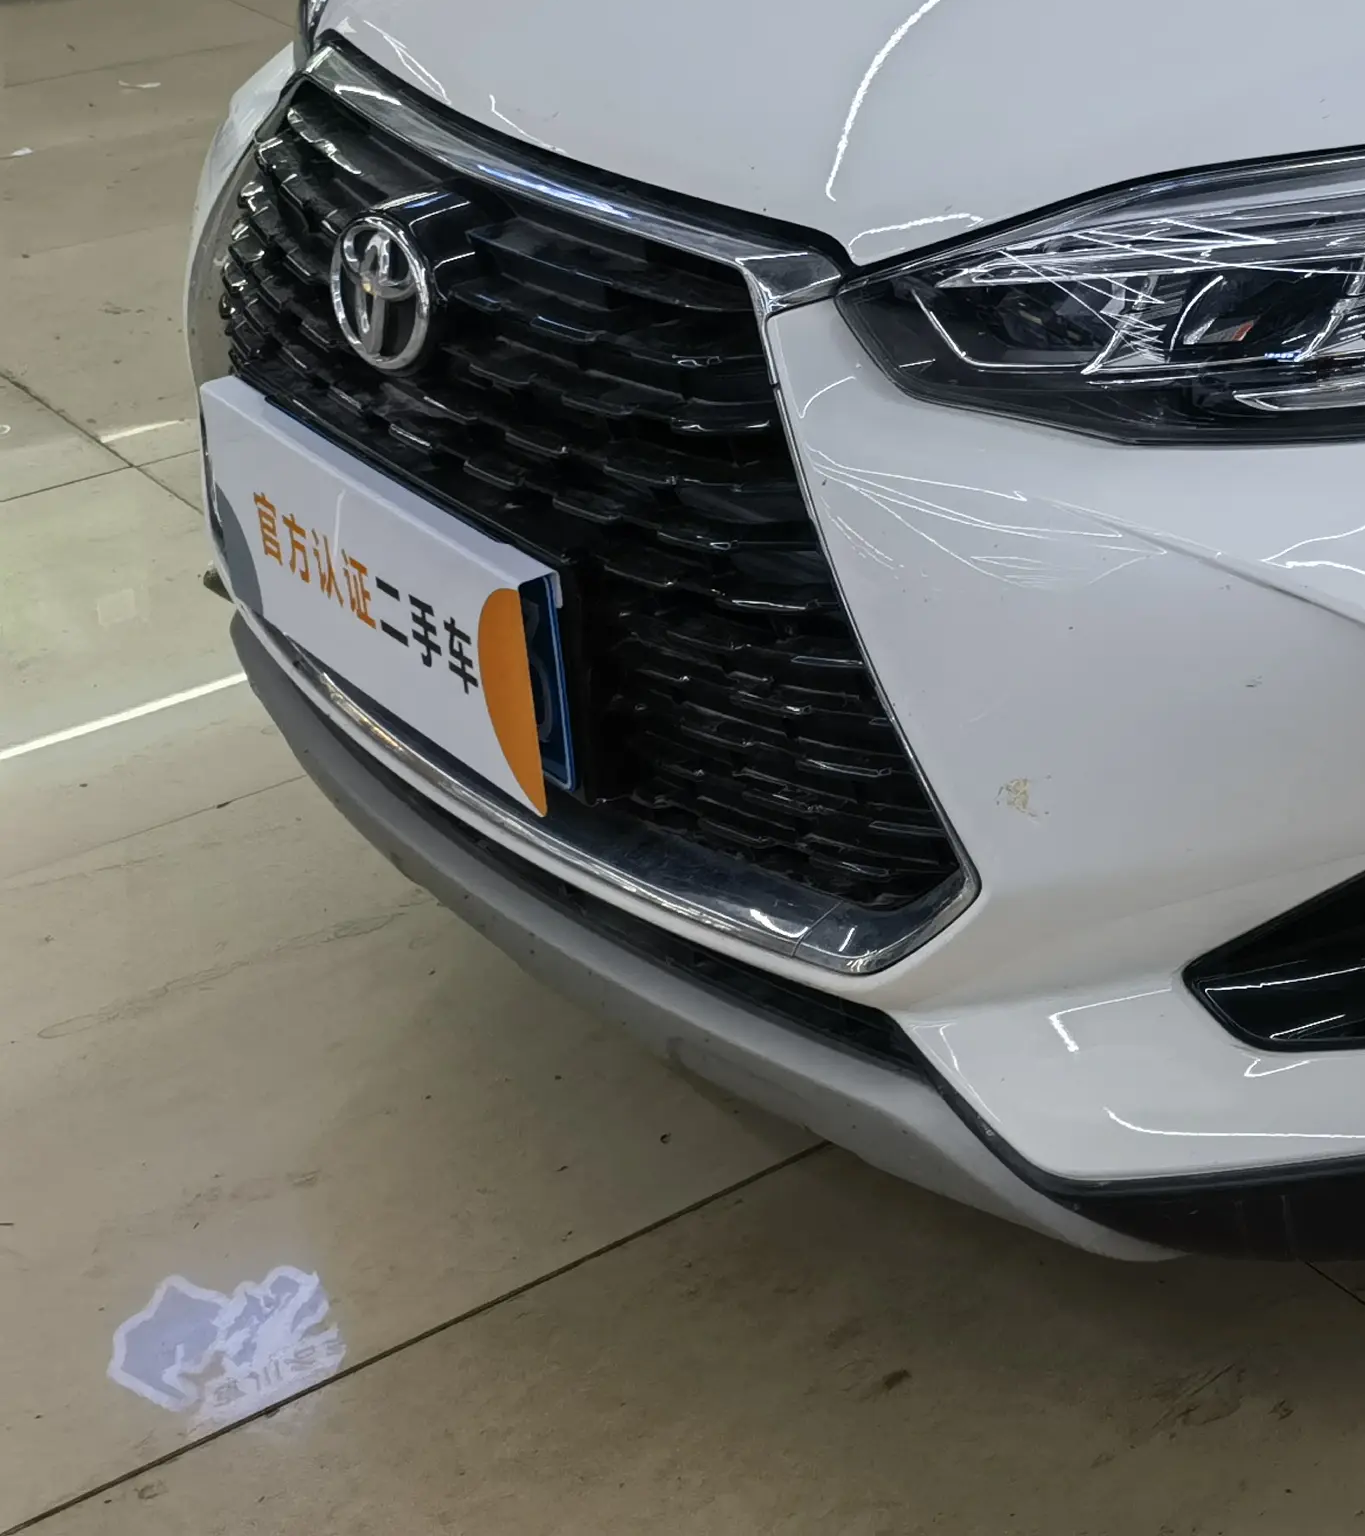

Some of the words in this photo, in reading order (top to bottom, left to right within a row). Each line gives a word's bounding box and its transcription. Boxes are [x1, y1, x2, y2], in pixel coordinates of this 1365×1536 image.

[253, 491, 480, 695] 官方认证二手车
